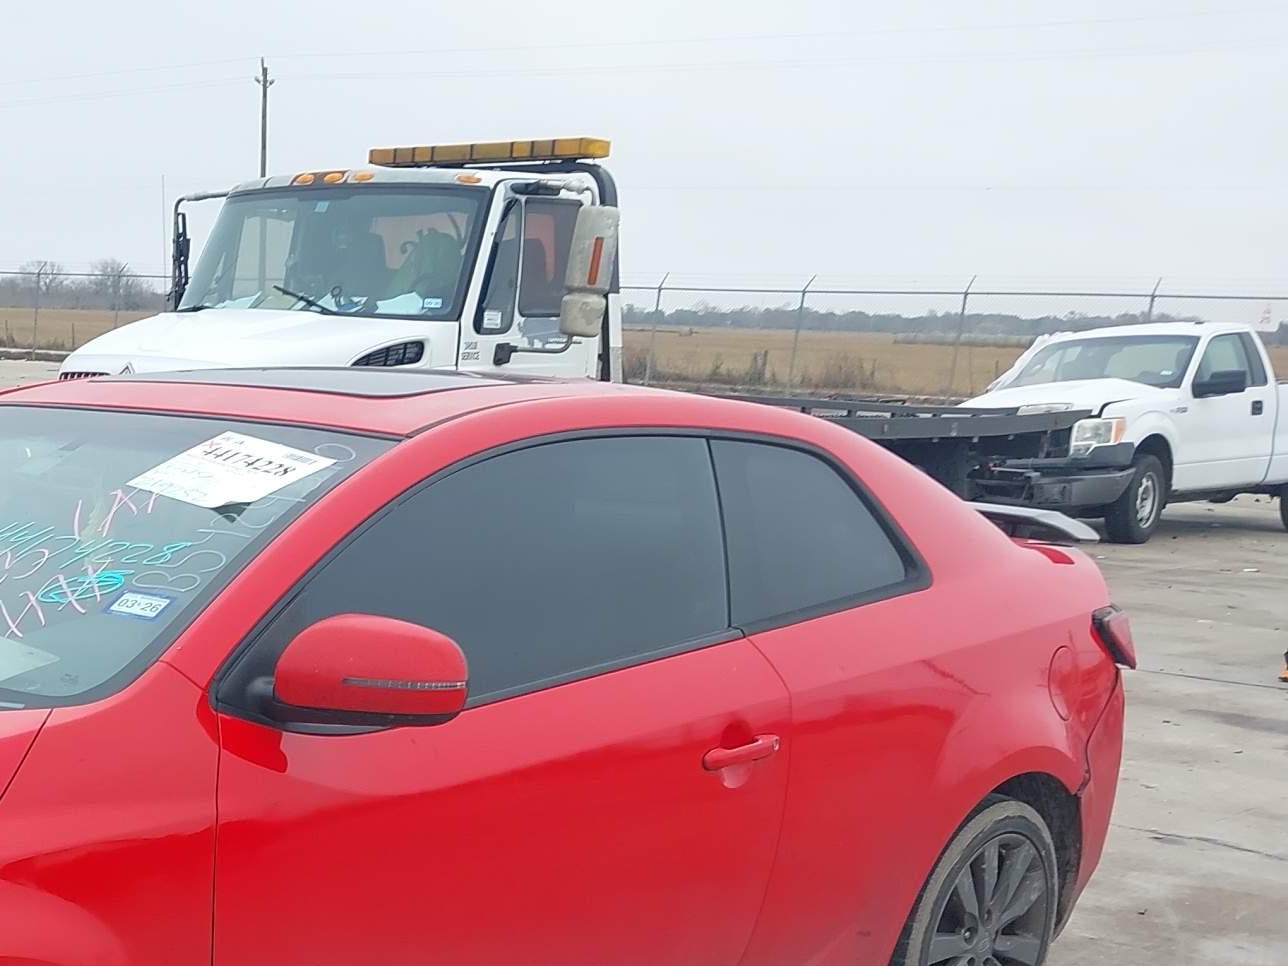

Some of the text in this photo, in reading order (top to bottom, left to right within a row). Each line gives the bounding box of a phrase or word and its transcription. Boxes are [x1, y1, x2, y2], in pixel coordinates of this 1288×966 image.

[202, 446, 297, 478] 44174228
[116, 598, 163, 613] 03 26
